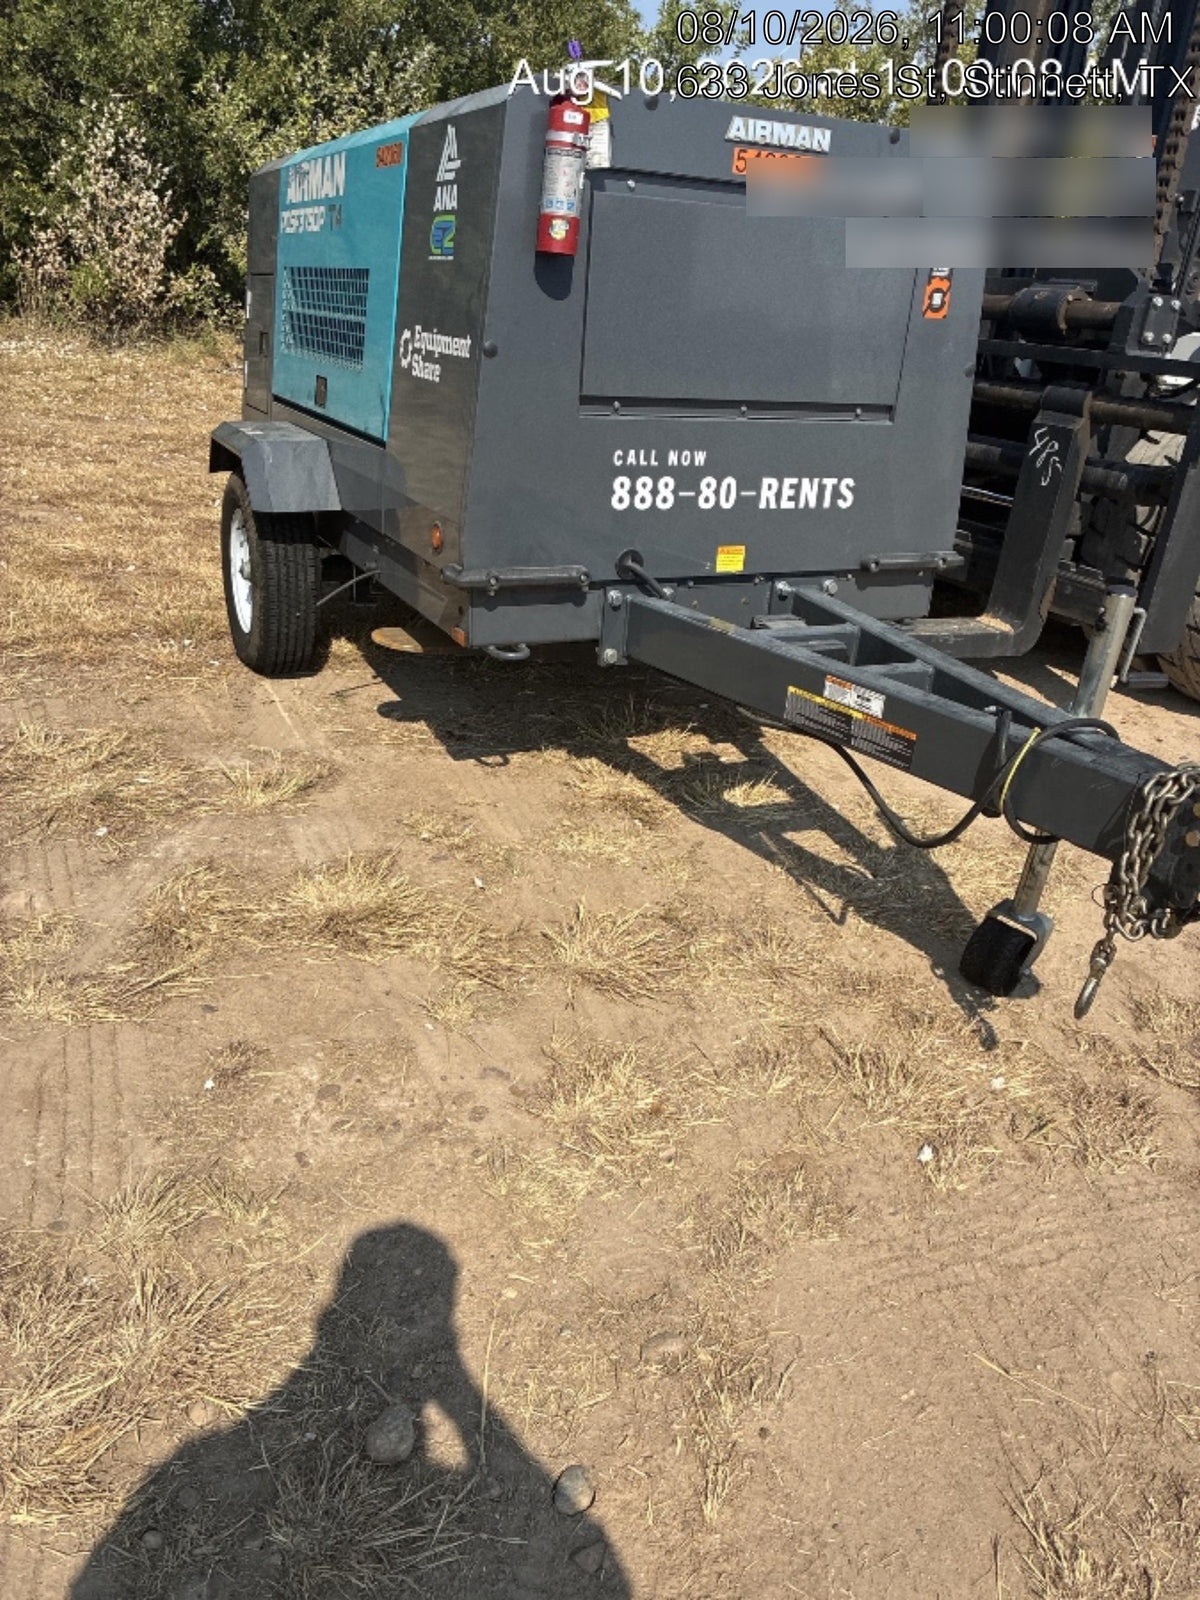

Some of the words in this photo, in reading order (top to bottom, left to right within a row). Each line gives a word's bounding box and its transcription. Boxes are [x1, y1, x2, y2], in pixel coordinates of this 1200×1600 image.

[724, 116, 832, 153] AIRMAN
[433, 184, 458, 212] ANA
[414, 324, 472, 358] Equipment
[411, 353, 441, 383] Share
[613, 450, 659, 466] CALL
[668, 450, 707, 466] NOW
[611, 475, 856, 510] 888-80-RENTS
